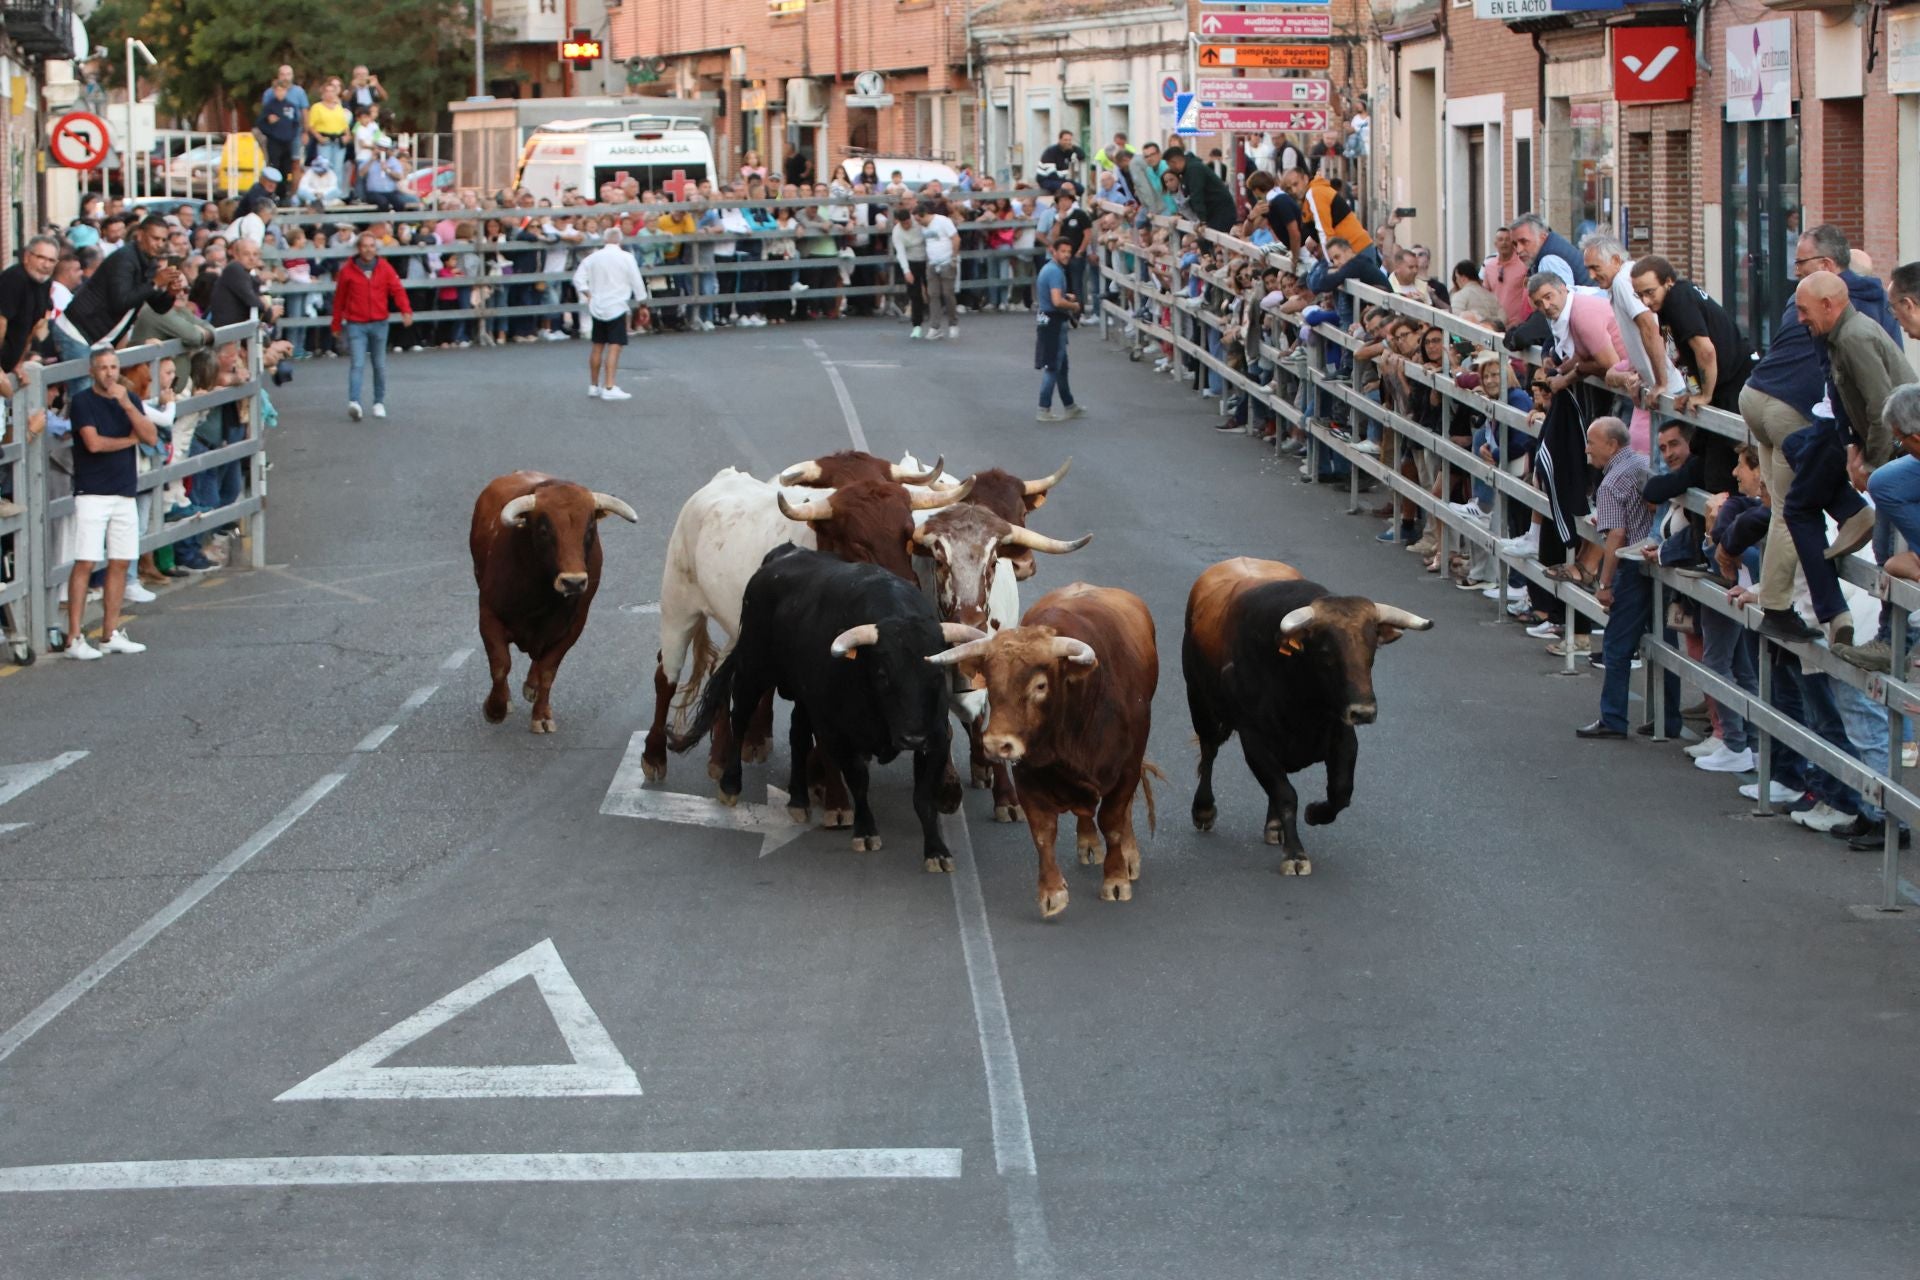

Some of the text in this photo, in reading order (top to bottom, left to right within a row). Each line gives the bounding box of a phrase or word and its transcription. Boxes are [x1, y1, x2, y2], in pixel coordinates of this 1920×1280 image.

[1491, 0, 1547, 14] EN EL ACTO
[1244, 17, 1328, 27] auditorio municipal
[1237, 48, 1326, 56] complejo deportivo
[1262, 57, 1288, 65] Pablo
[1200, 82, 1234, 91] palacio
[1201, 90, 1253, 99] Las Salinas
[1200, 111, 1229, 119] centro
[1200, 119, 1289, 128] San Vicente Ferrer
[609, 144, 690, 155] AMBULANCIA
